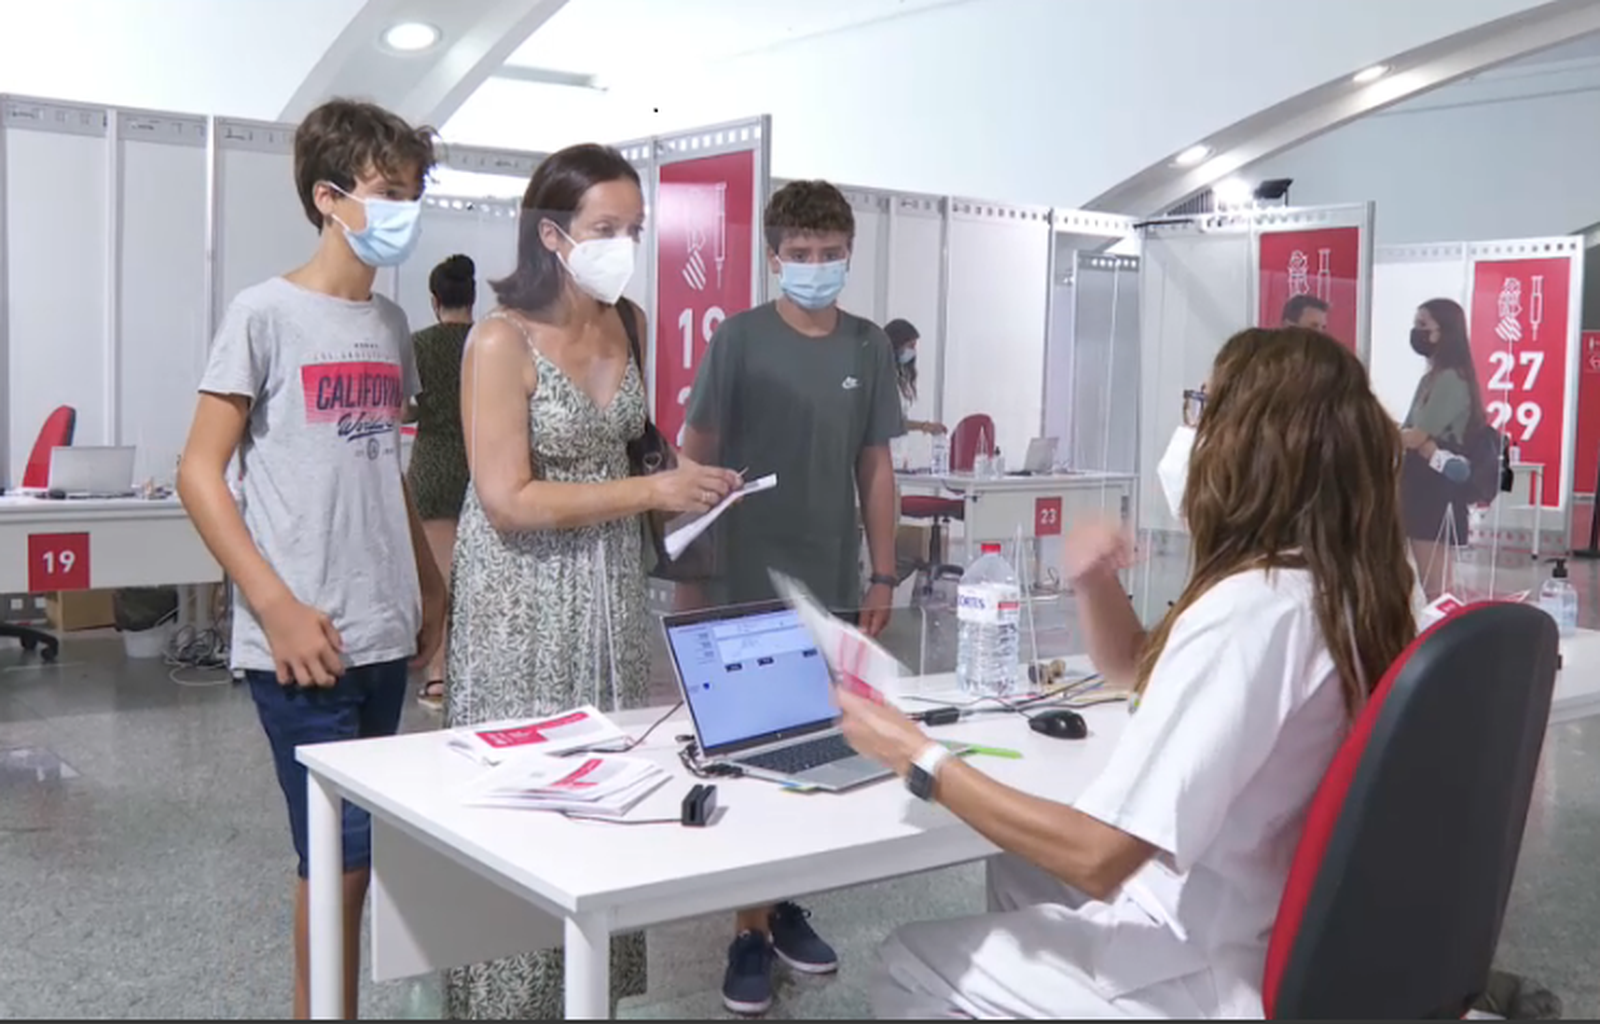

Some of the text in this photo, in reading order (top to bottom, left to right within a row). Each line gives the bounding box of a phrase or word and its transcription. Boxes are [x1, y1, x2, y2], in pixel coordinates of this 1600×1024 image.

[1487, 350, 1545, 390] 27
[1486, 400, 1542, 441] 29
[1041, 507, 1057, 525] 23
[42, 549, 76, 574] 19
